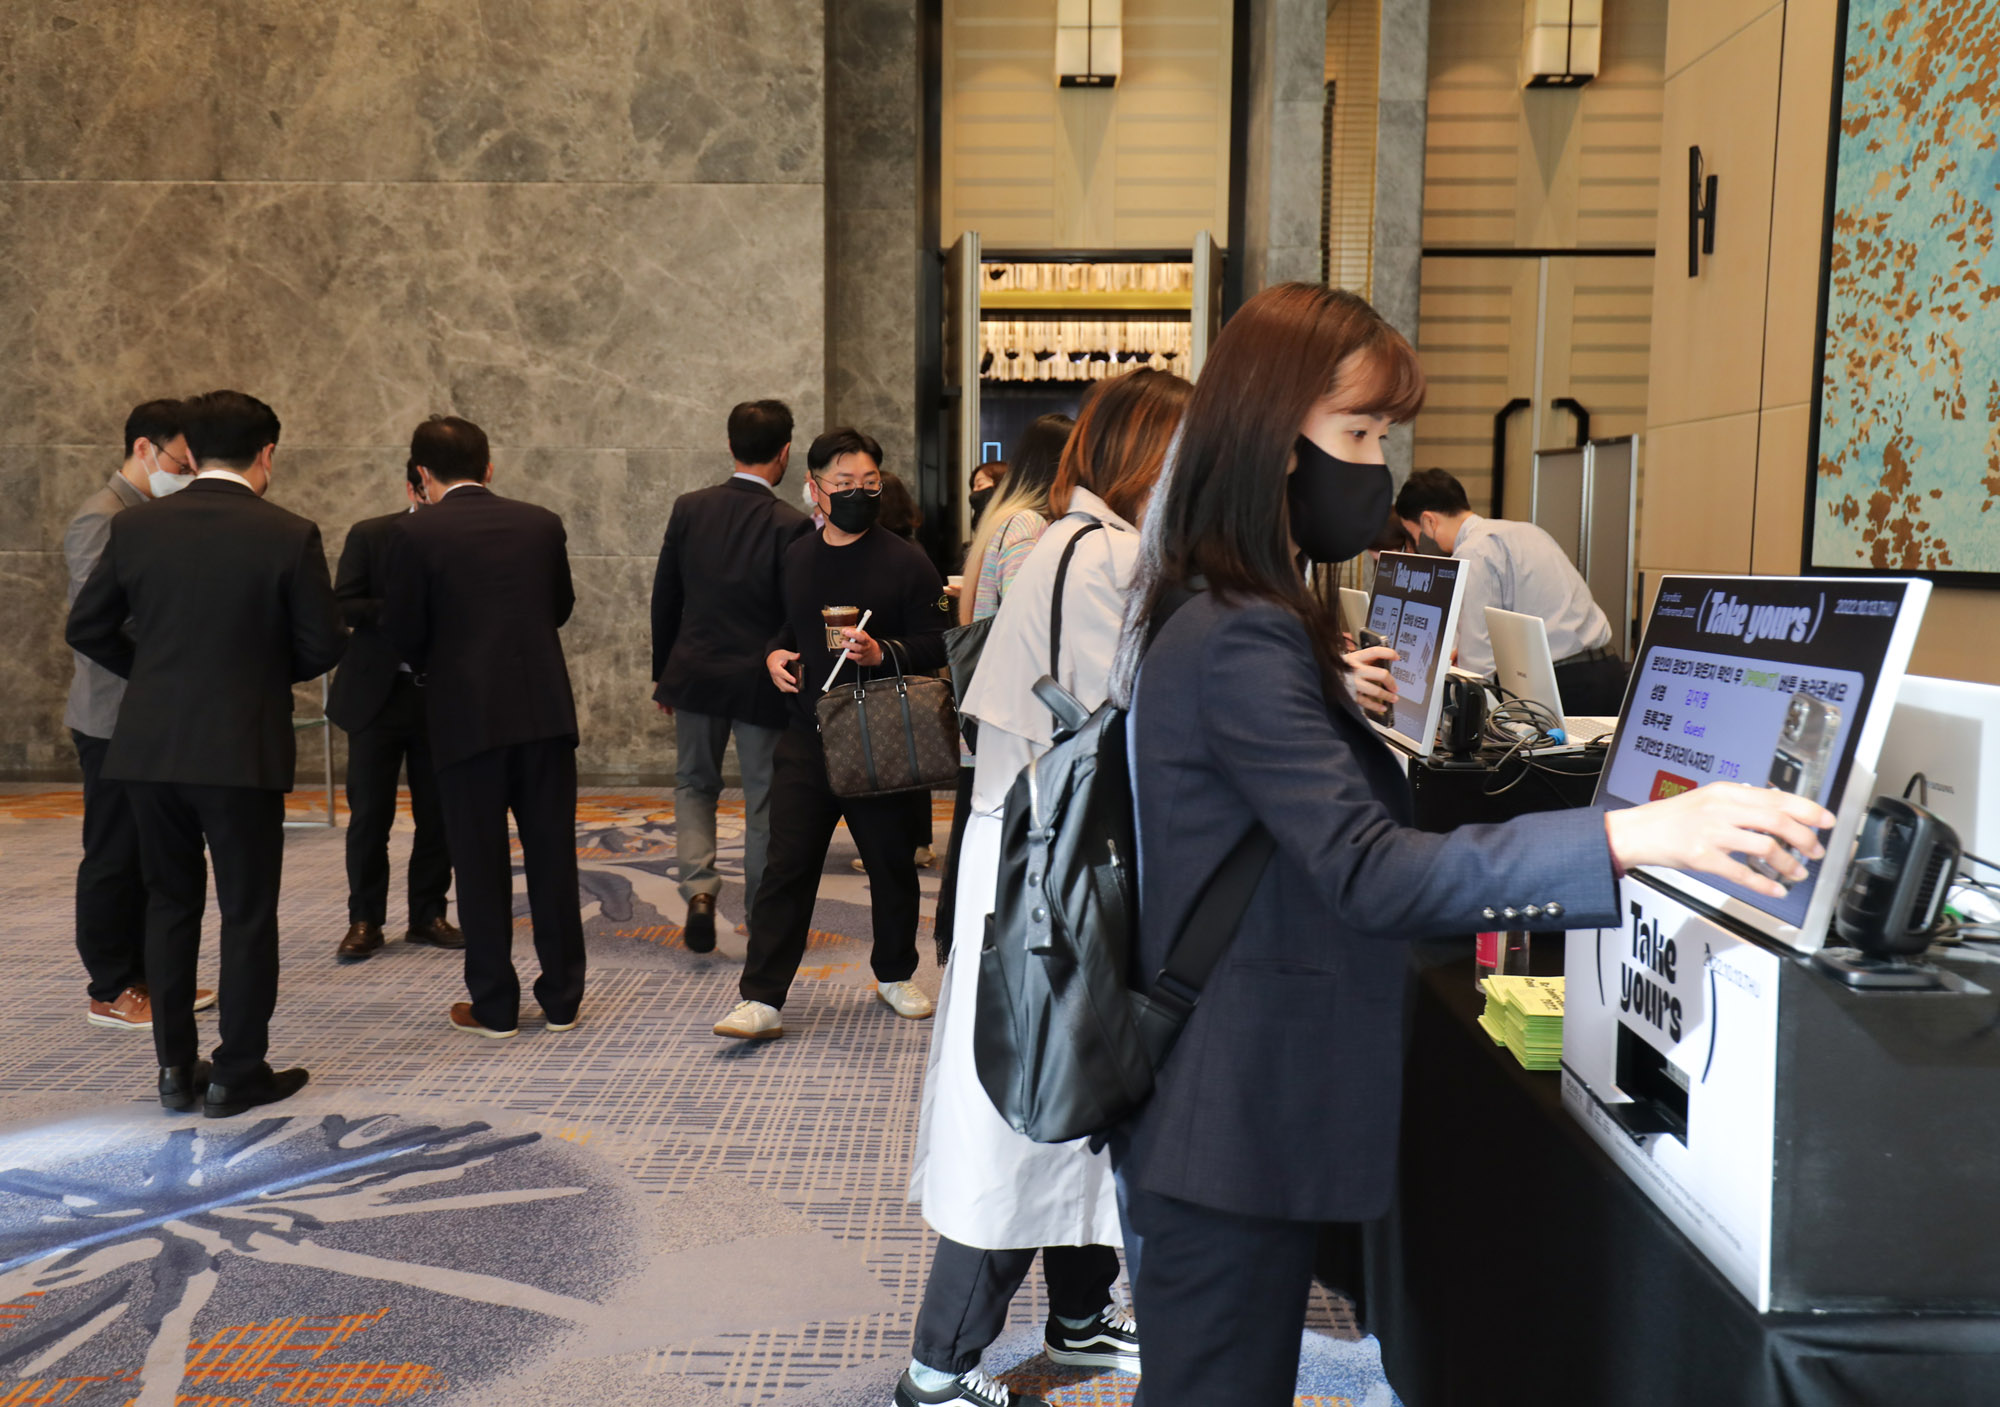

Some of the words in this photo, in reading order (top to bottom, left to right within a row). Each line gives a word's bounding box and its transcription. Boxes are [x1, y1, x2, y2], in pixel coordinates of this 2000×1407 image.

[1651, 656, 1673, 673] 본인의
[1650, 684, 1668, 702] 성명
[1683, 720, 1706, 738] Guest
[1717, 759, 1740, 779] 3715
[1630, 899, 1678, 985] Take
[1620, 960, 1682, 1044] yours
